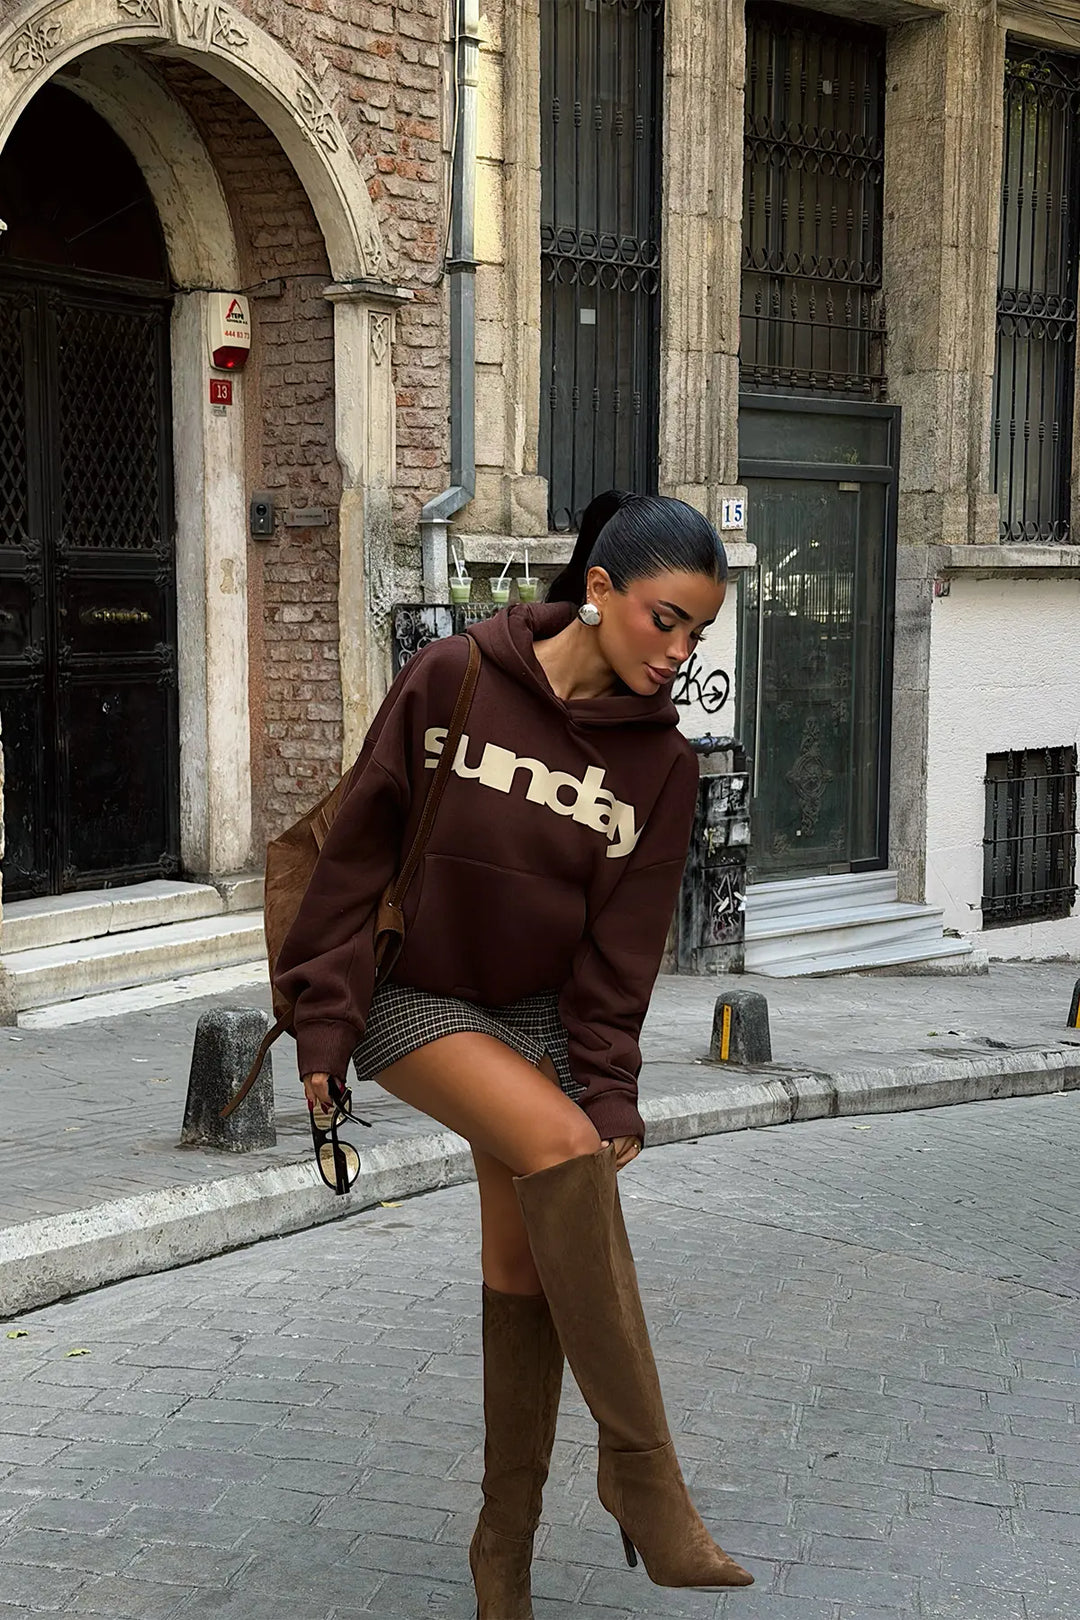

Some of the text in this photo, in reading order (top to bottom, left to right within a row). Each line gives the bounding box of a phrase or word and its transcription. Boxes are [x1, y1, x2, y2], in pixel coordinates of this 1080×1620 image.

[217, 384, 228, 399] 13
[725, 504, 742, 523] 15
[424, 727, 645, 858] sunday
